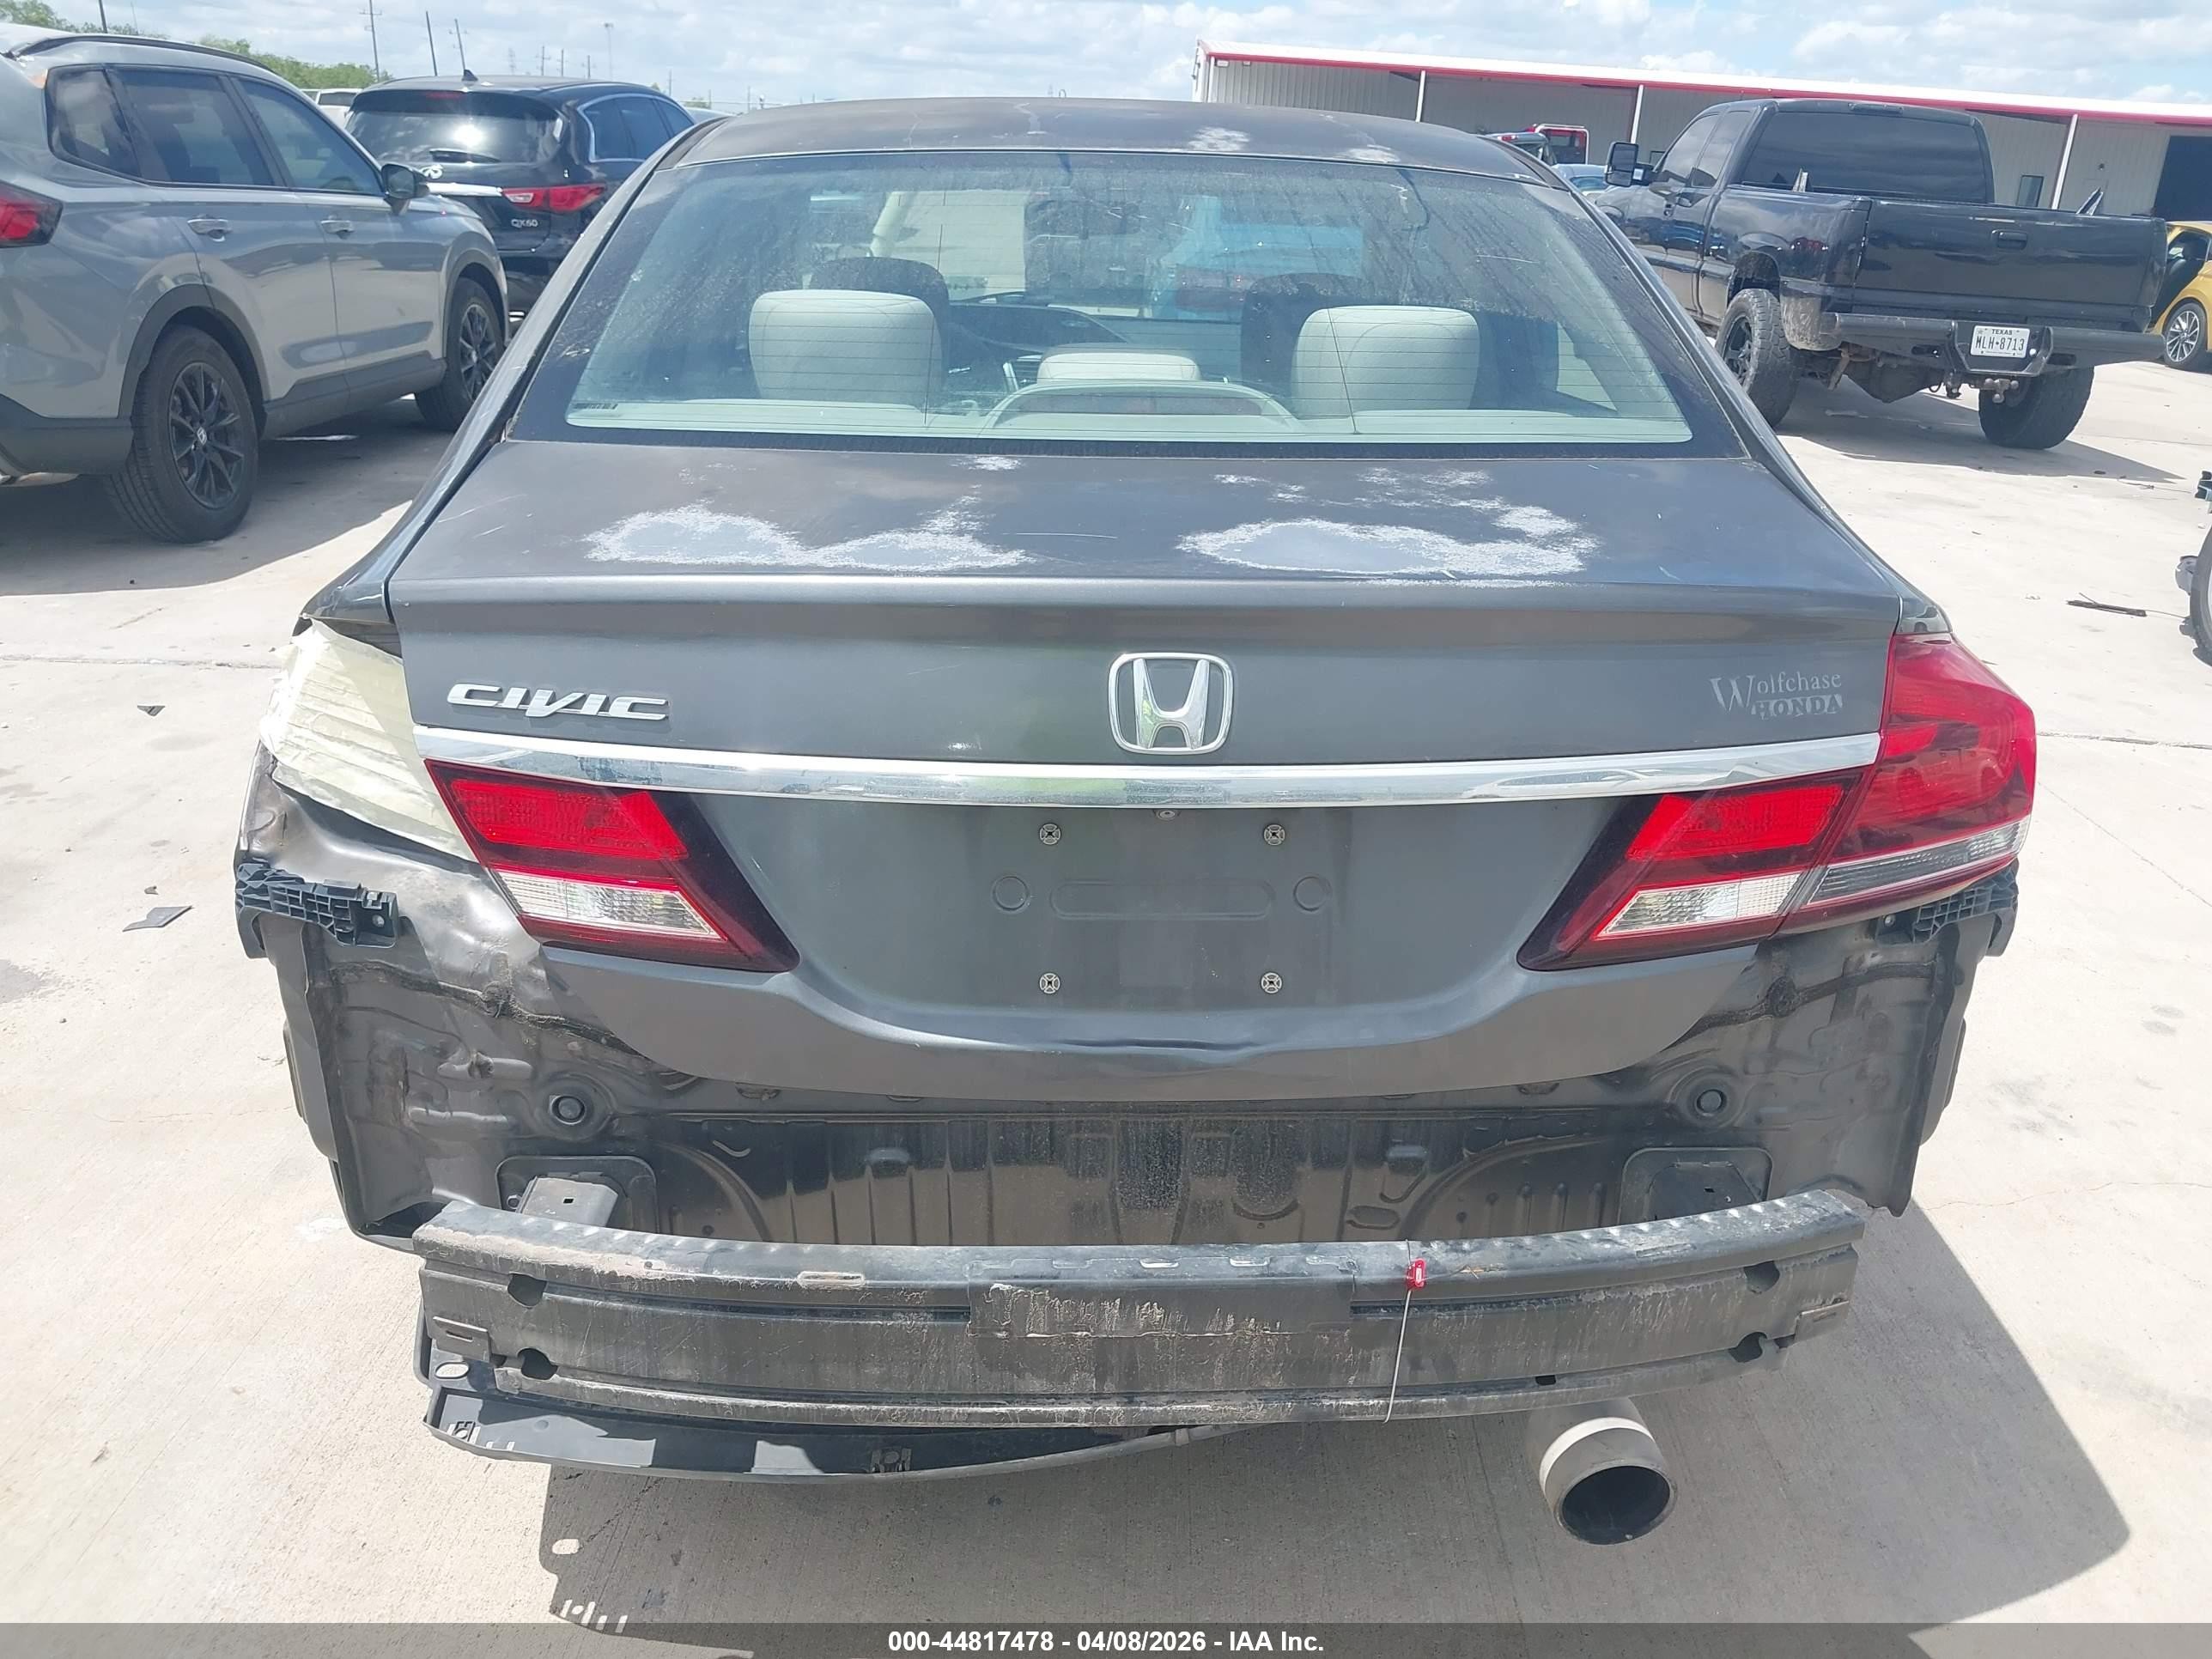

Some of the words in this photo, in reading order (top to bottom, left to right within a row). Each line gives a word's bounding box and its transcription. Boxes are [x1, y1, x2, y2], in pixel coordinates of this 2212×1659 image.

[447, 684, 670, 720] CIVIC
[1710, 672, 1842, 712] Wolfchase
[1751, 694, 1844, 720] HONDA
